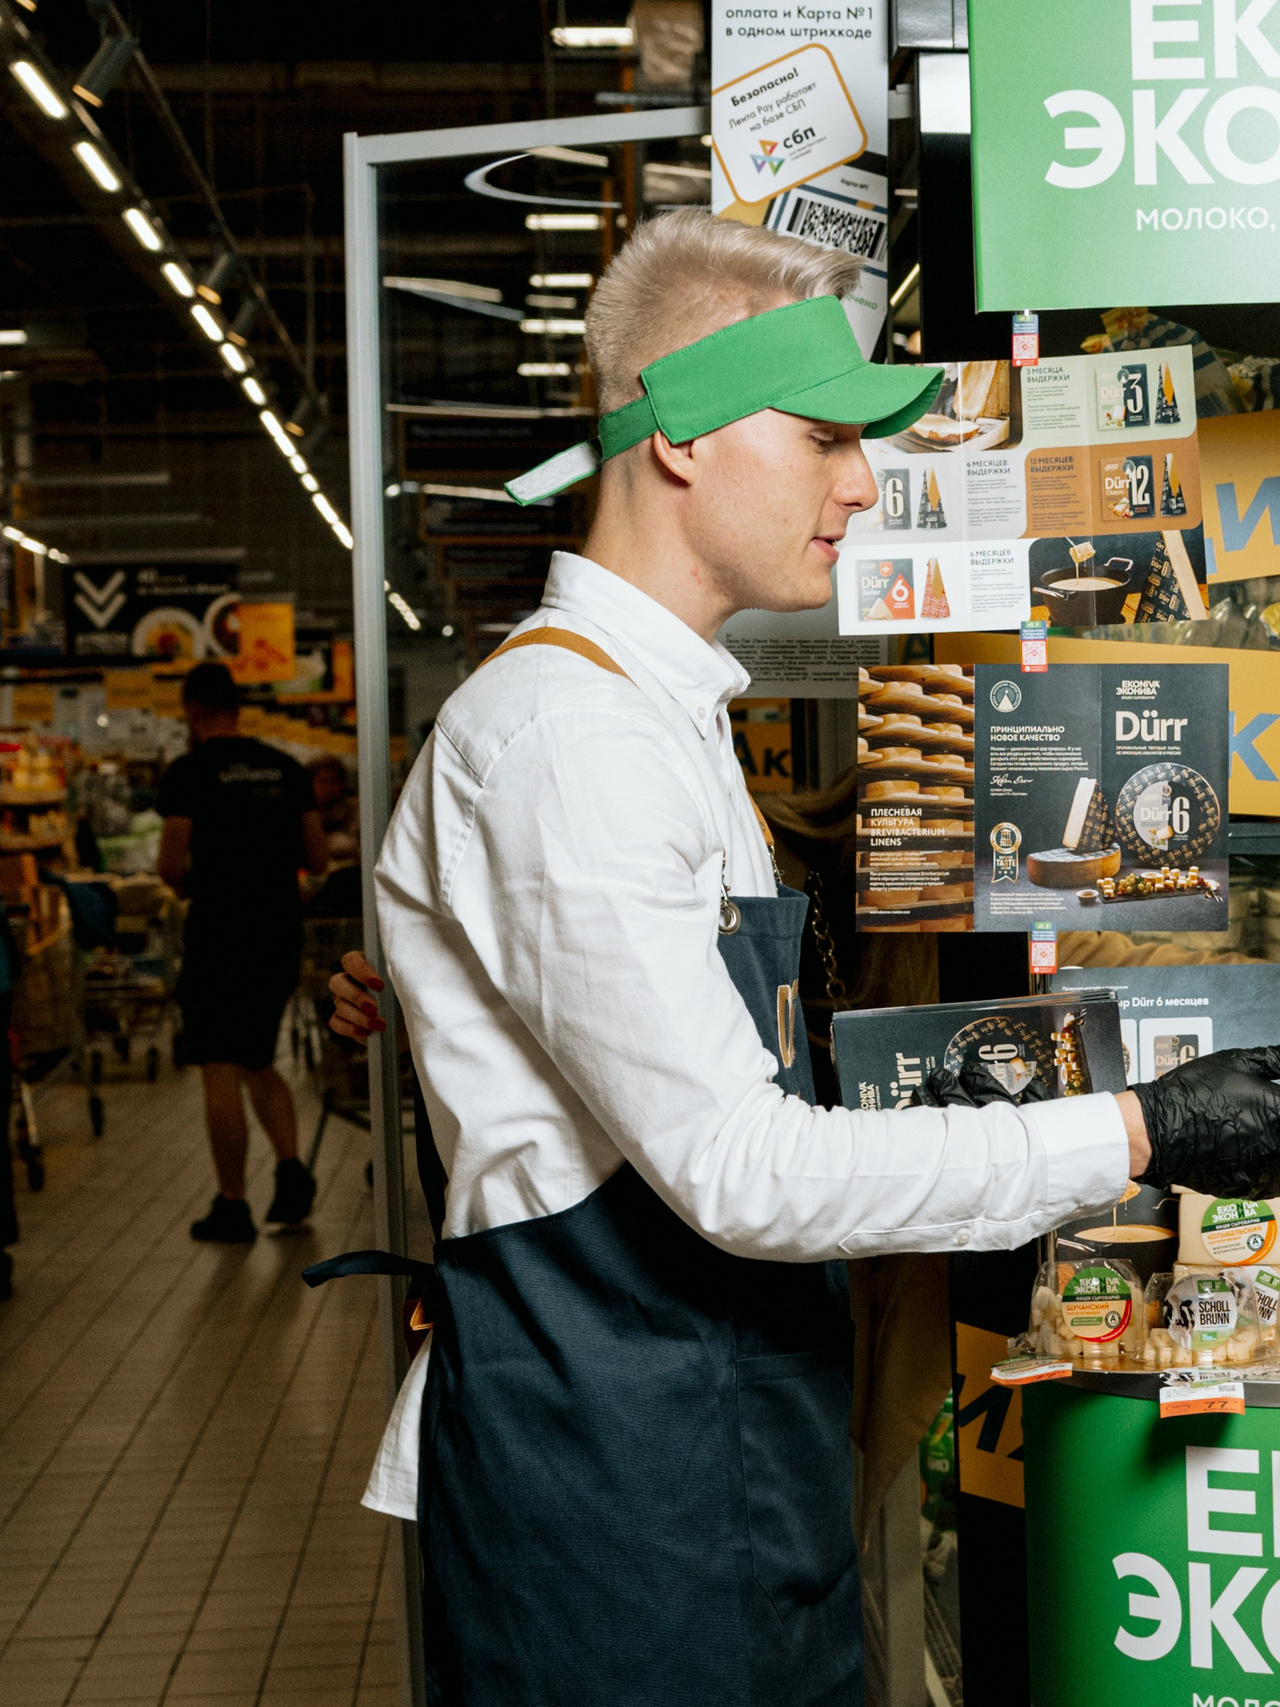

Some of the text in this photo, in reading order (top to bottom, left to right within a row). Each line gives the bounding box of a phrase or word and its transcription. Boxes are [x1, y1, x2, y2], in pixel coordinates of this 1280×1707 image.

[726, 9, 778, 20] оплата
[784, 9, 791, 19] и
[798, 6, 842, 23] Карта
[726, 27, 872, 40] в одном штрихкоде
[730, 67, 799, 107] Безопасно!
[729, 81, 818, 130] Лента Pay работает
[750, 99, 807, 133] на базе СБП
[783, 124, 817, 150] сбп
[1136, 207, 1277, 233] МОЛОКО,
[1027, 375, 1070, 383] ВЫДЕРЖКИ
[1127, 373, 1143, 413] 3
[973, 459, 1008, 467] МЕСЯЦЕВ
[1038, 456, 1074, 464] МЕСЯЦЕВ
[967, 467, 1011, 476] ВЫДЕРЖКИ
[1030, 464, 1074, 473] ВЫДЕРЖКИ
[1105, 465, 1150, 506] Dürr 12
[885, 477, 904, 517] 6
[976, 549, 1012, 557] МЕСЯЦЕВ
[970, 557, 1015, 566] ВЫДЕРЖКИ
[860, 576, 909, 601] Dürr 6
[990, 726, 1065, 734] ПРИНЦИПИАЛЬНО
[1115, 709, 1188, 742] Dürr
[1019, 734, 1061, 742] КАЧЕСТВО
[870, 808, 922, 817] ПЛЕСНЕВАЯ
[1172, 796, 1190, 834] 6
[870, 818, 915, 826] КУЛЬТУРА
[870, 828, 945, 836] BREVIBACTERIUM
[870, 838, 902, 846] LINENS
[1132, 997, 1210, 1007] Dürr 6 месяцев
[1156, 1054, 1180, 1066] Dürr
[1216, 1201, 1260, 1215] EKONIVA
[1212, 1208, 1257, 1223] ЭКОНИВА
[1073, 1285, 1118, 1294] ЭКОНИВА
[1066, 1302, 1109, 1311] ЩУЧАНСКИЙ
[1199, 1300, 1231, 1313] SCHOLL
[1200, 1312, 1230, 1325] BRUNN
